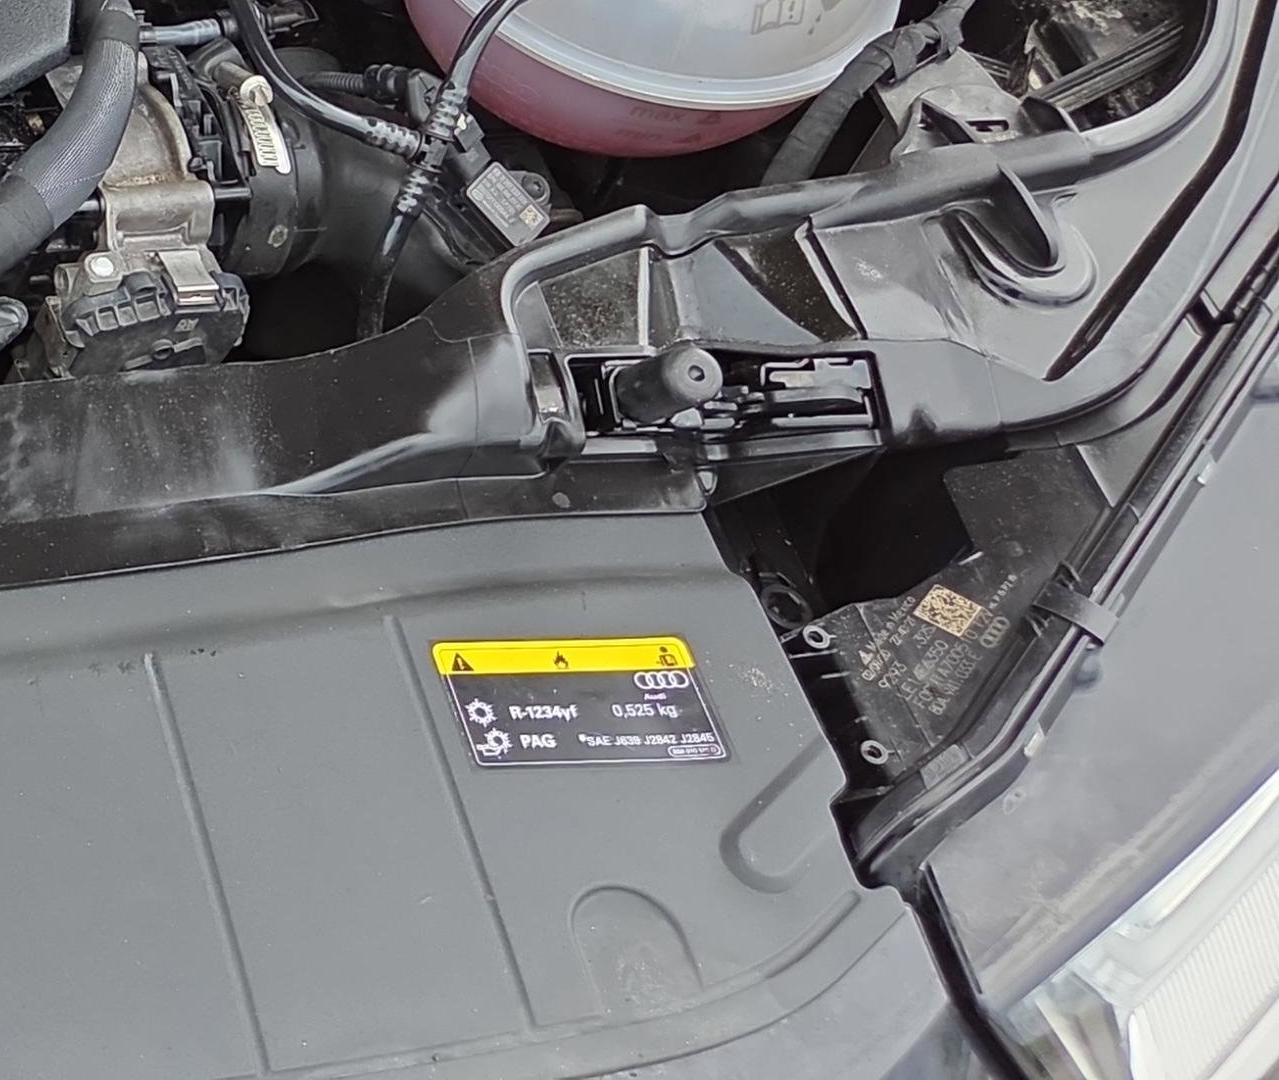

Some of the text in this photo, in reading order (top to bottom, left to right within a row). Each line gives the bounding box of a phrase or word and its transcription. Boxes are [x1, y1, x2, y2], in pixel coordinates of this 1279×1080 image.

[644, 692, 667, 701] Audi
[509, 703, 679, 723] R-1234yf 0,525 kg
[520, 734, 556, 749] PAG
[680, 732, 715, 744] J2845
